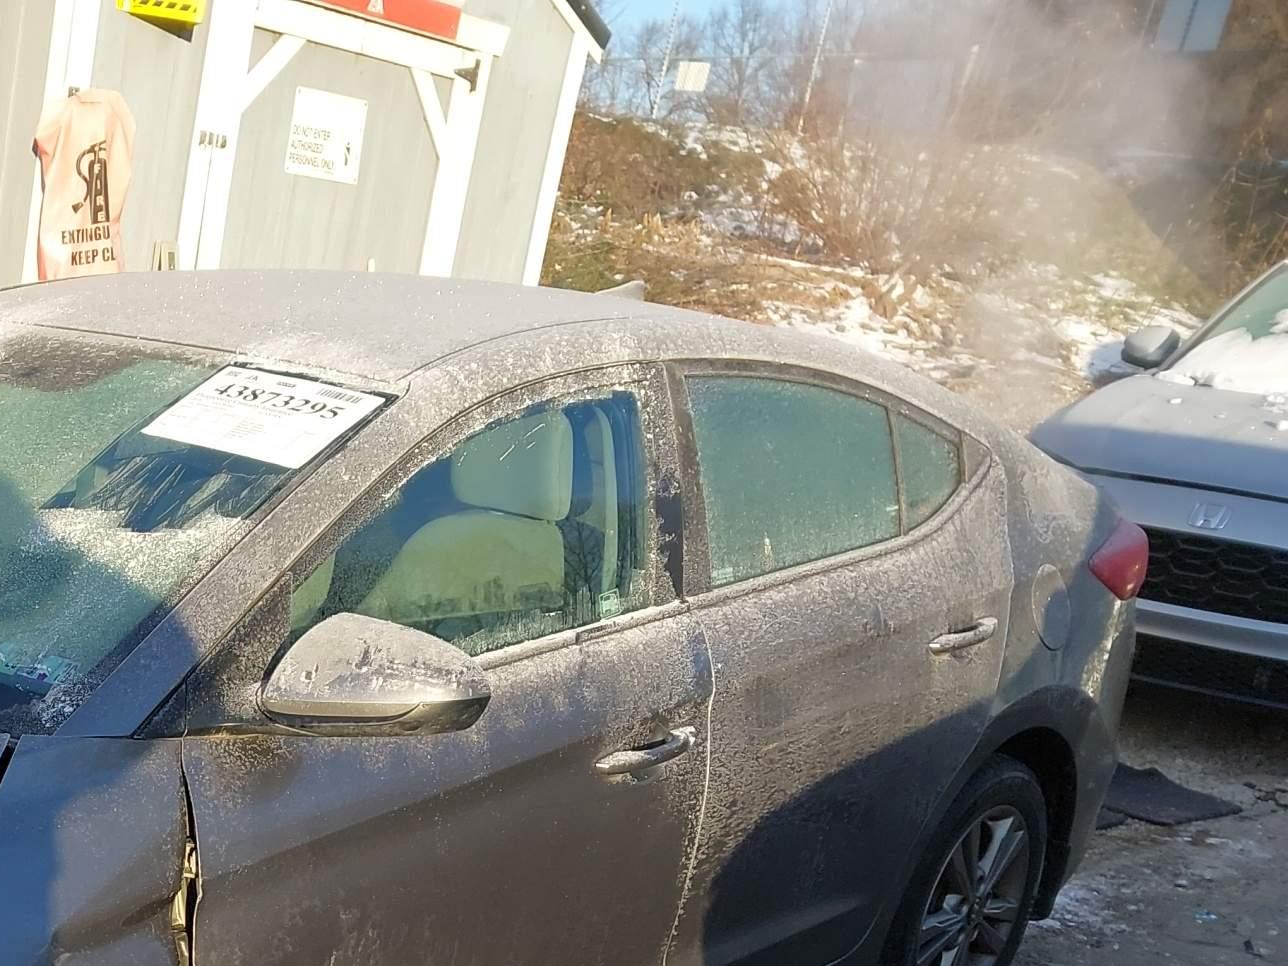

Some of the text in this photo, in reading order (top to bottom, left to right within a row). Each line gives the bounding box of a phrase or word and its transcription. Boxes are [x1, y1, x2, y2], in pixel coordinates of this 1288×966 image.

[94, 163, 105, 221] FIRE
[71, 249, 98, 266] KEEP
[214, 383, 345, 419] 43873295
